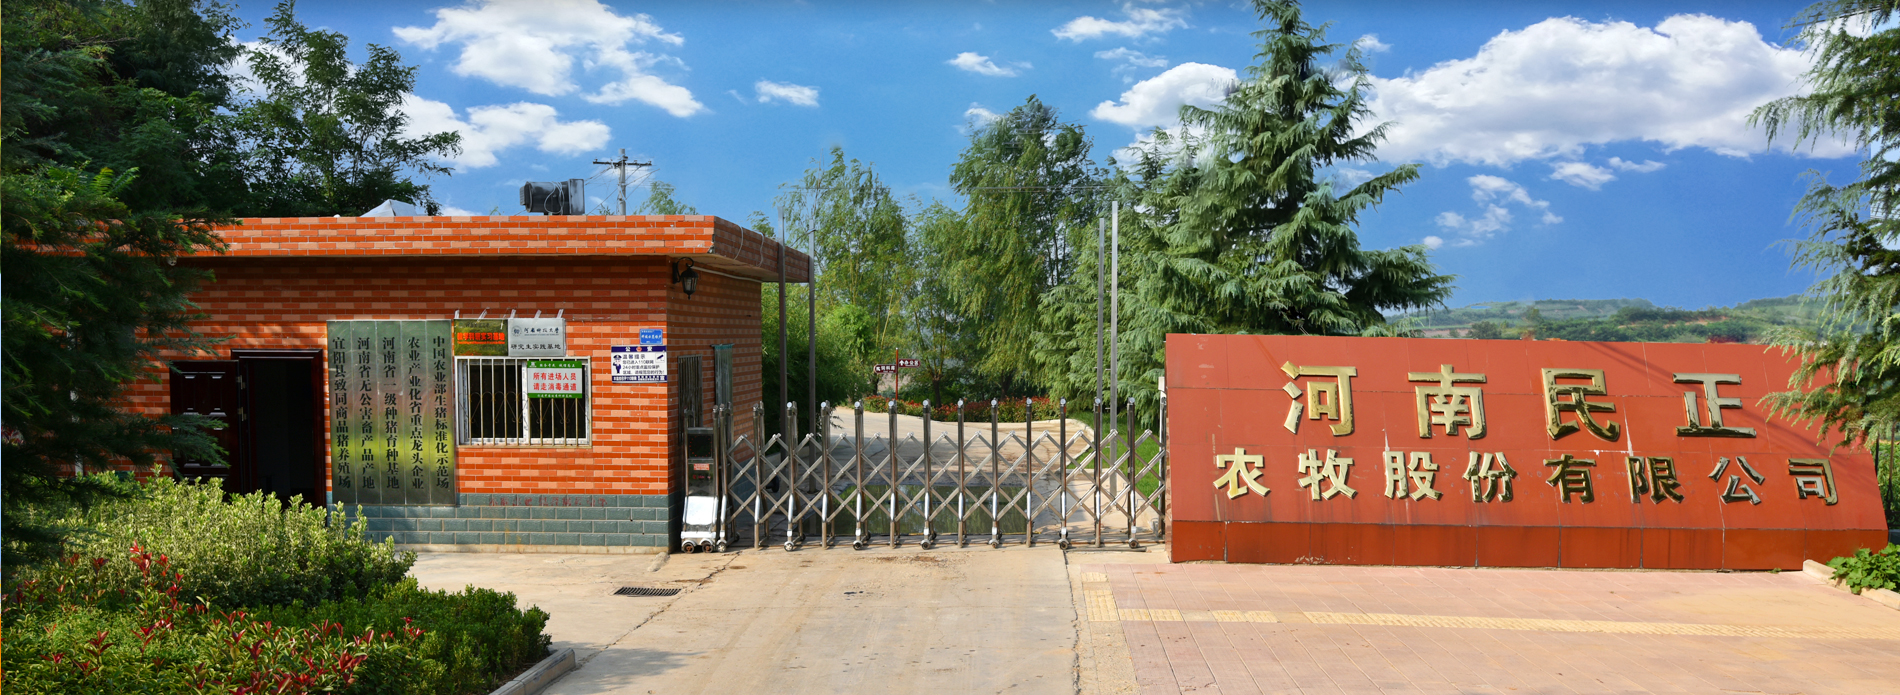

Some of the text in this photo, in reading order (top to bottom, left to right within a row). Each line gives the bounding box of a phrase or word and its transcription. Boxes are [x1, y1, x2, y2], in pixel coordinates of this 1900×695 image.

[332, 337, 351, 489] 宜阳县致同商品猪养殖场
[357, 337, 375, 489] 河南省无公害畜产品产地
[382, 336, 400, 489] 河南省一级种猪育种基地
[407, 336, 424, 490] 农业产业化省重点龙头企业
[432, 336, 449, 489] 中国农业部生猪标准化示范场
[533, 372, 577, 381] 所有进场人员
[533, 382, 577, 391] 请走消毒通道
[1280, 360, 1757, 442] 河南民正
[1213, 446, 1838, 507] 农牧股份有限公司
